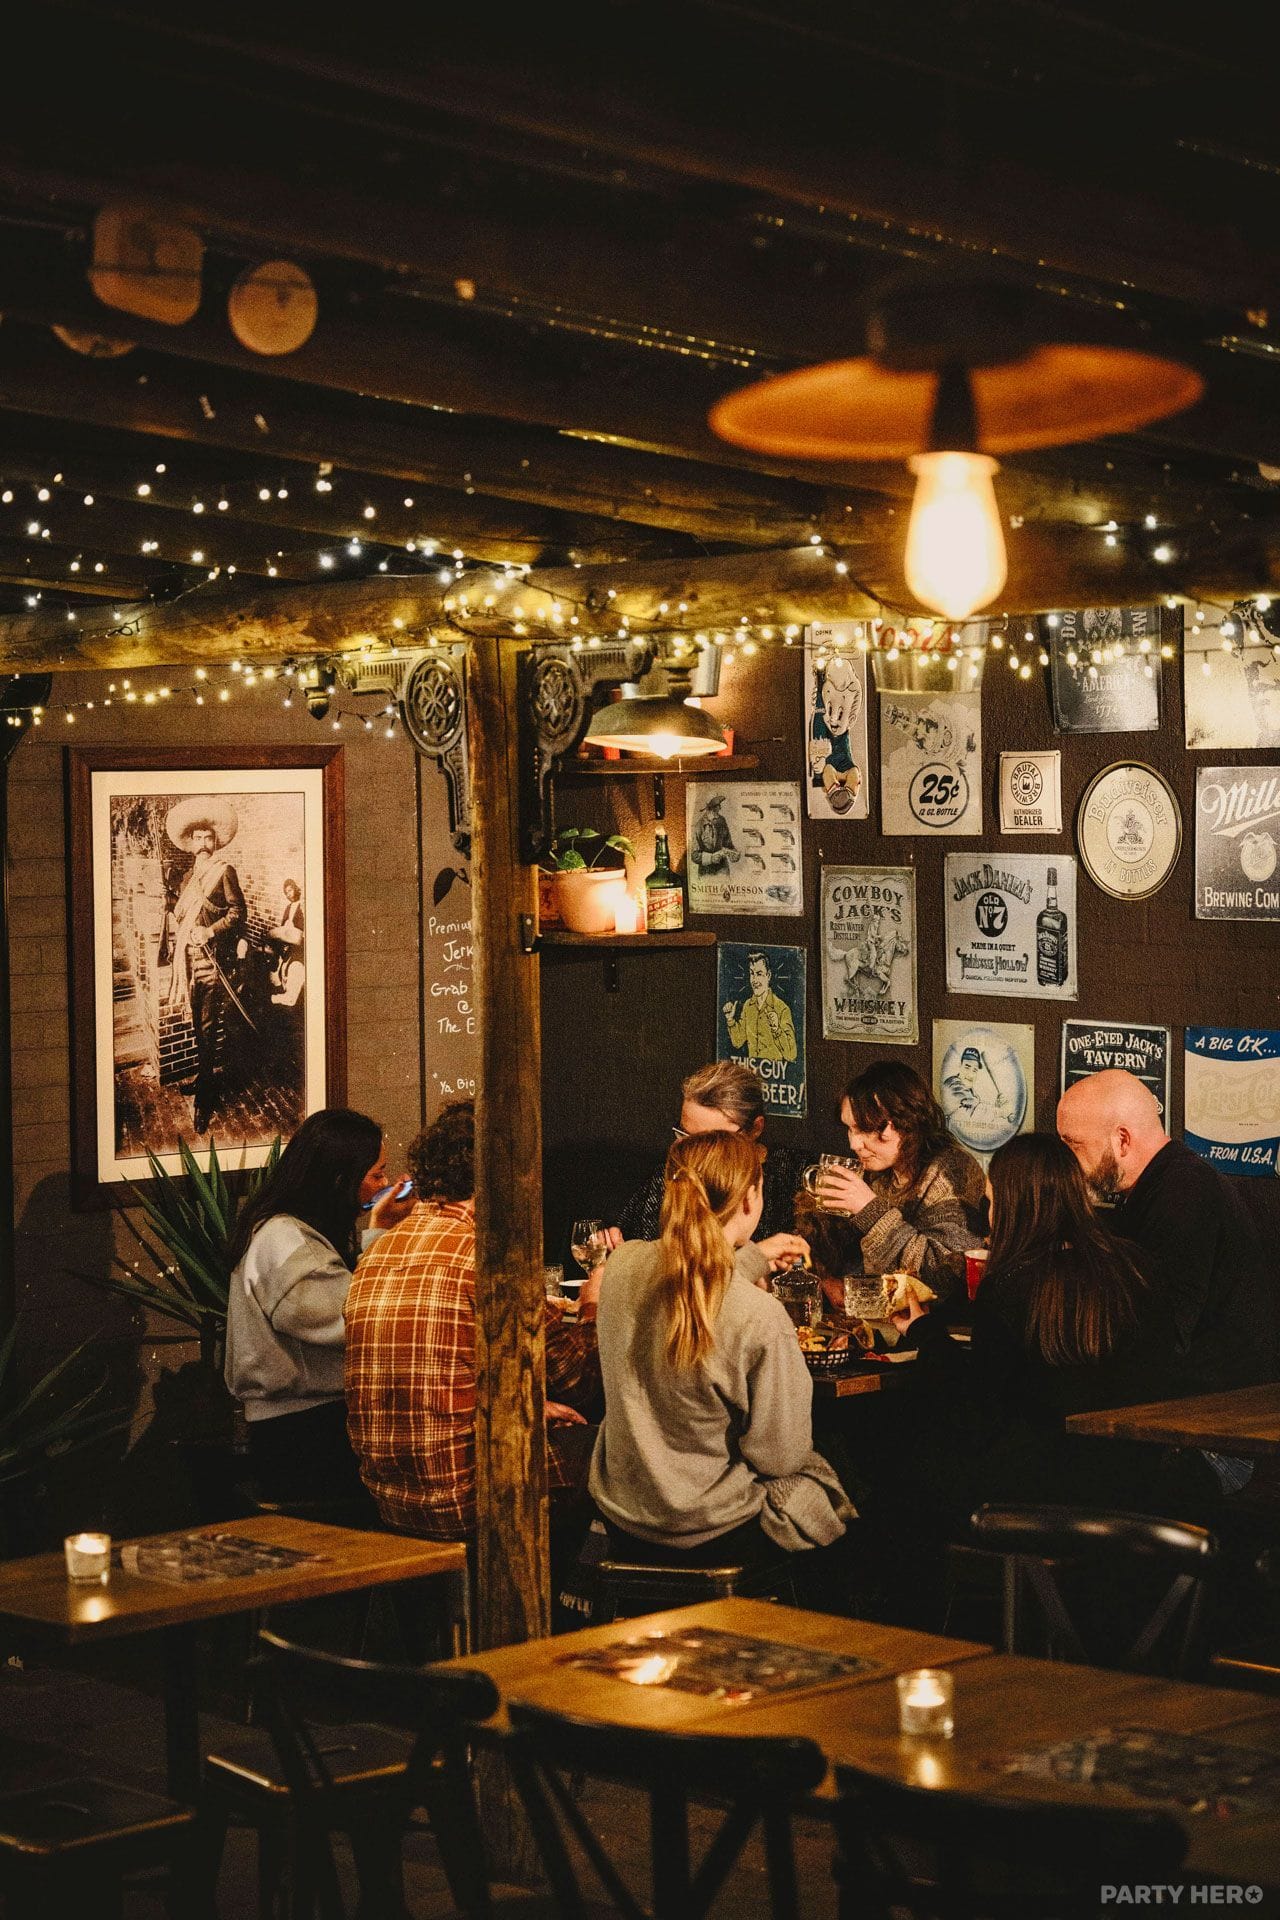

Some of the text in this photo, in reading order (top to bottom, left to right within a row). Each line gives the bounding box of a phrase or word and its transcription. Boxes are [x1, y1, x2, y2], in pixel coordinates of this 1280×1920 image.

[1060, 608, 1077, 639] DO
[1013, 764, 1039, 780] BRUTAL
[919, 774, 960, 805] 25¢
[1012, 783, 1041, 803] BREWING
[919, 808, 926, 816] 12
[936, 807, 958, 816] BOTTLE
[1088, 780, 1167, 825] Budweiser
[1014, 815, 1043, 826] DEALER
[1120, 859, 1157, 883] BOTTLES
[691, 882, 718, 894] SMITH
[728, 884, 764, 895] WESSON
[953, 863, 1034, 905] JACK DANIEL'S
[831, 885, 904, 907] COWBOY
[1204, 886, 1253, 908] BREWING
[834, 904, 902, 922] JACK'S
[429, 916, 472, 937] Premiu
[971, 942, 986, 950] MADE
[987, 943, 993, 951] IN
[999, 944, 1016, 952] QUIET
[431, 980, 468, 997] Grab
[833, 997, 906, 1016] WHISKEY
[437, 1017, 461, 1034] The
[1069, 1030, 1163, 1060] ONE-EYED JACK'S
[1194, 1036, 1206, 1049] A
[1208, 1036, 1233, 1051] BIG
[1083, 1050, 1147, 1069] TAVERN
[760, 1059, 788, 1080] GUY
[457, 1079, 475, 1096] Big
[761, 1082, 805, 1110] BEER!
[1241, 1147, 1273, 1165] U.S.A.
